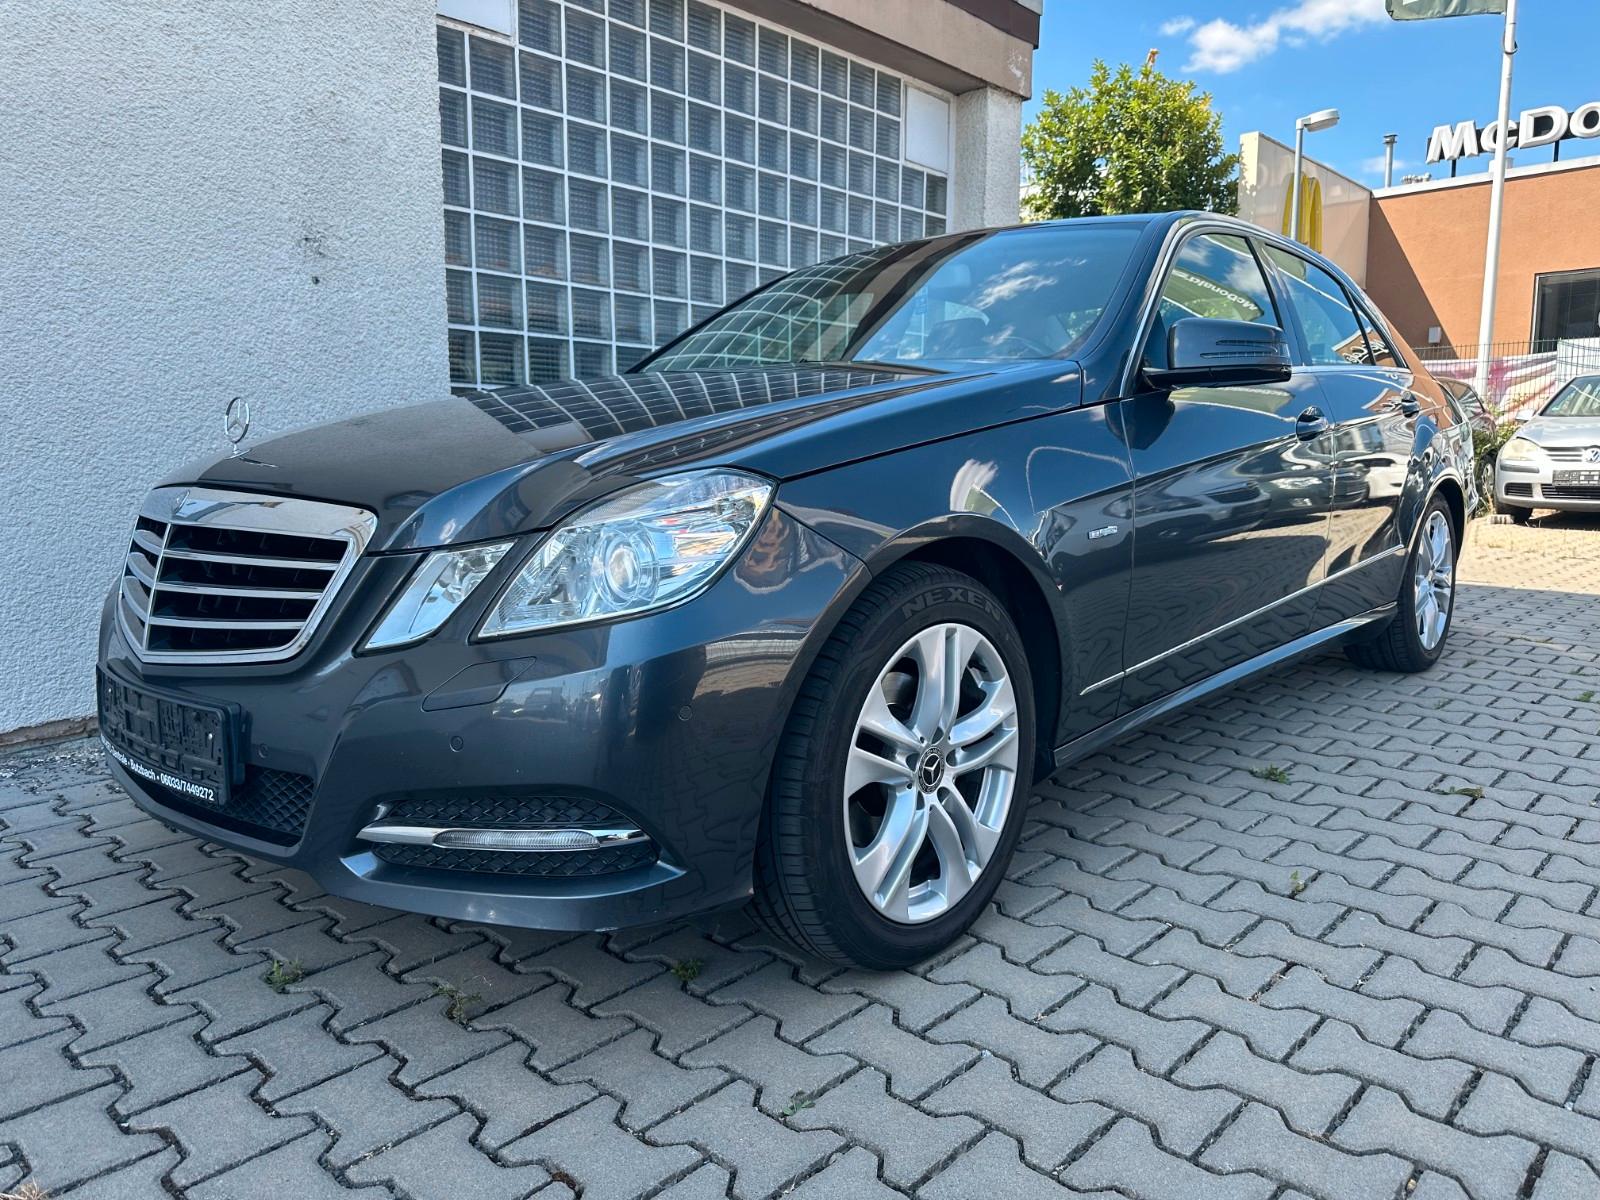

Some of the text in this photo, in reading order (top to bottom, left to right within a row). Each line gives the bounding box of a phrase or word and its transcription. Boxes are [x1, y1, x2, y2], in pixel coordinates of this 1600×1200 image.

[902, 587, 1001, 620] NEXEN
[130, 759, 215, 801] Butzbach 06033/7449272
